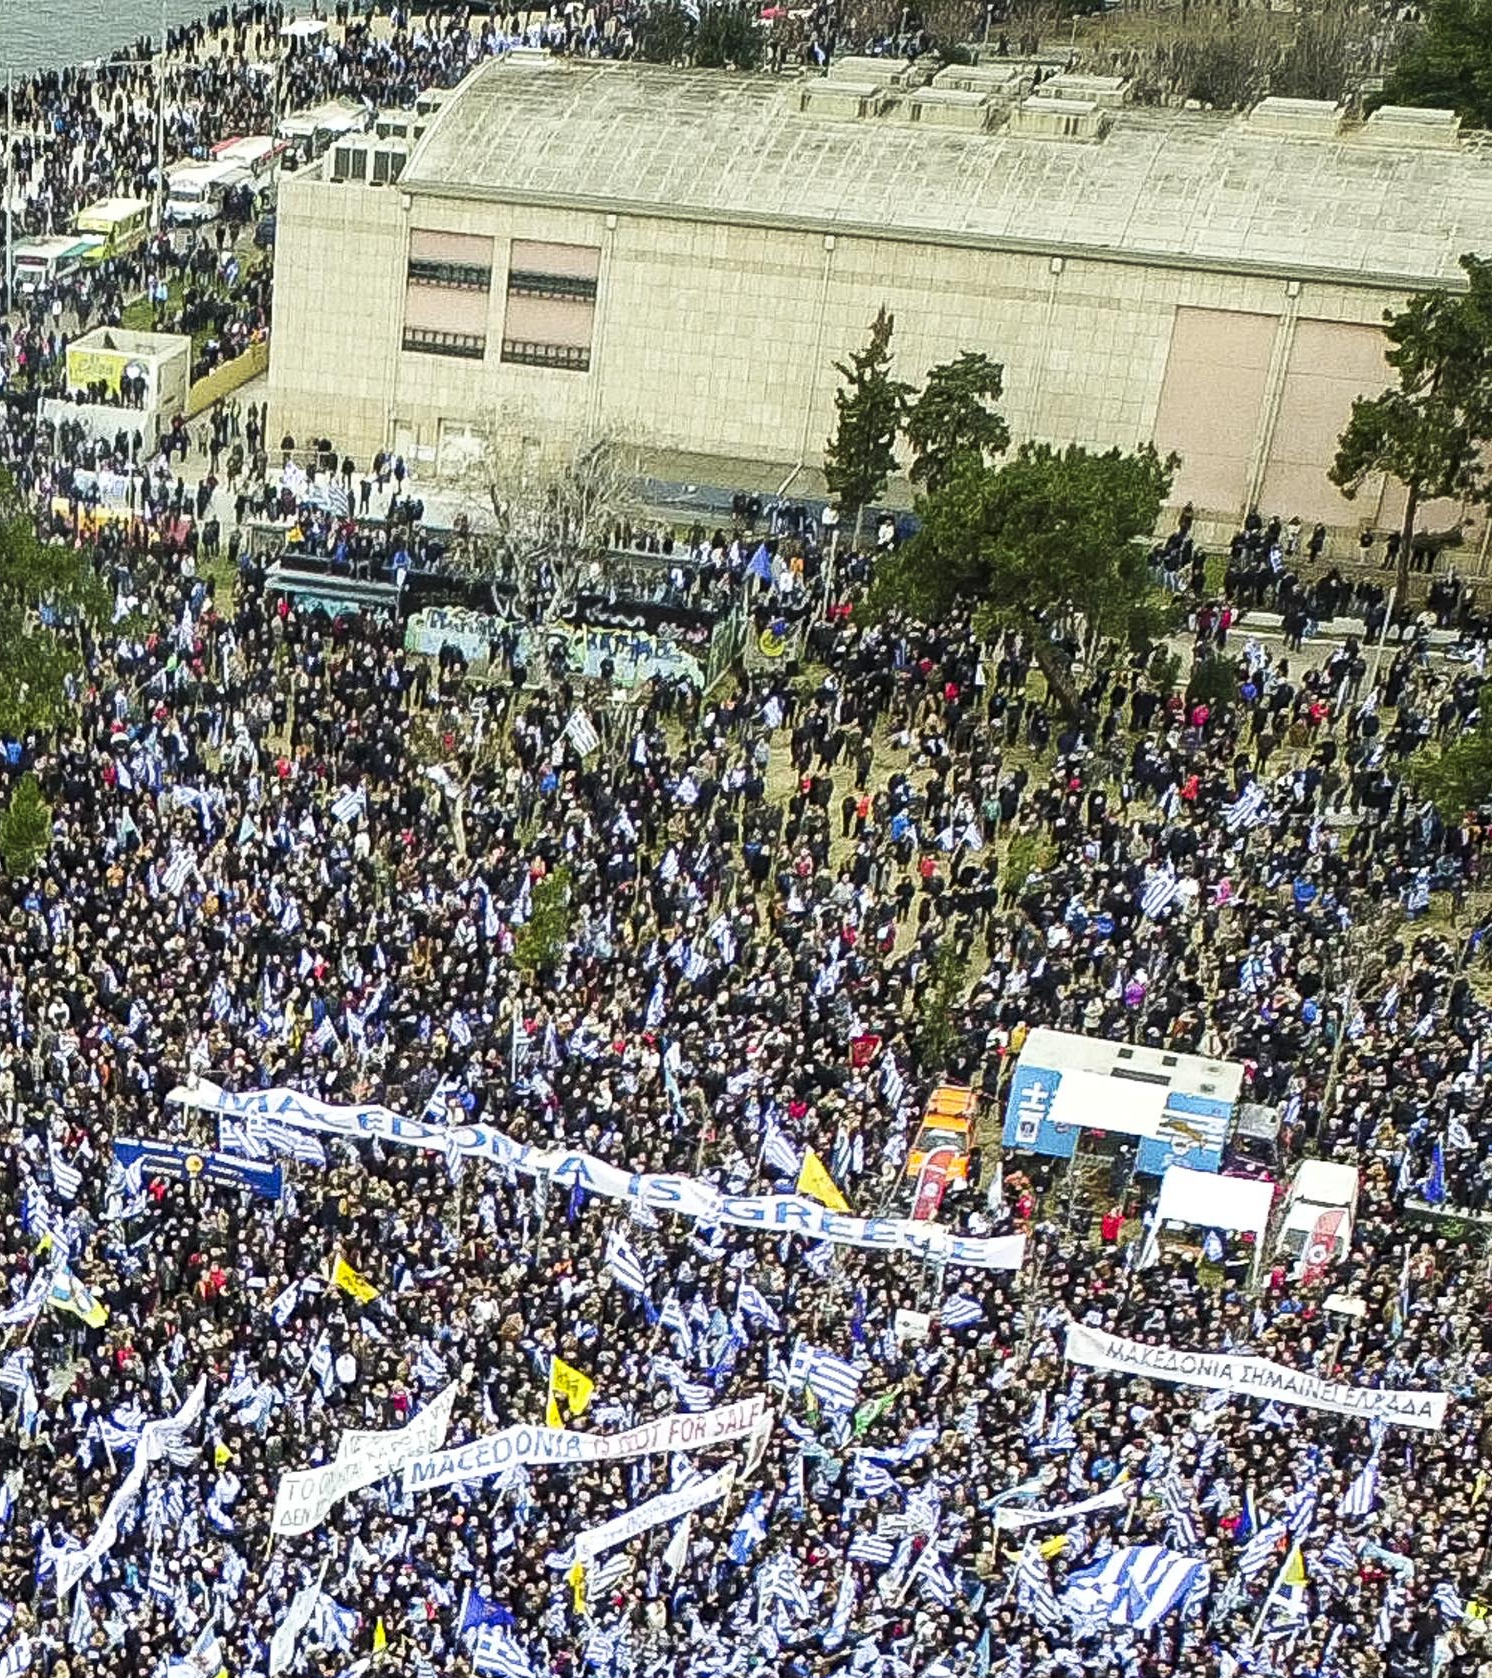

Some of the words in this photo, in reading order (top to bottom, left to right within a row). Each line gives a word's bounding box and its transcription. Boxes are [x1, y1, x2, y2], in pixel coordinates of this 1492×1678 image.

[627, 1173, 681, 1201] IS
[1106, 1341, 1232, 1381] ΜΑΚΕΔΟΝΙΑ
[1239, 1364, 1339, 1404] ΣΗΜΑΙΝΕΙ
[410, 1428, 581, 1485] MACEDONIA
[668, 1414, 707, 1443] FOR
[713, 1402, 761, 1437] SALE
